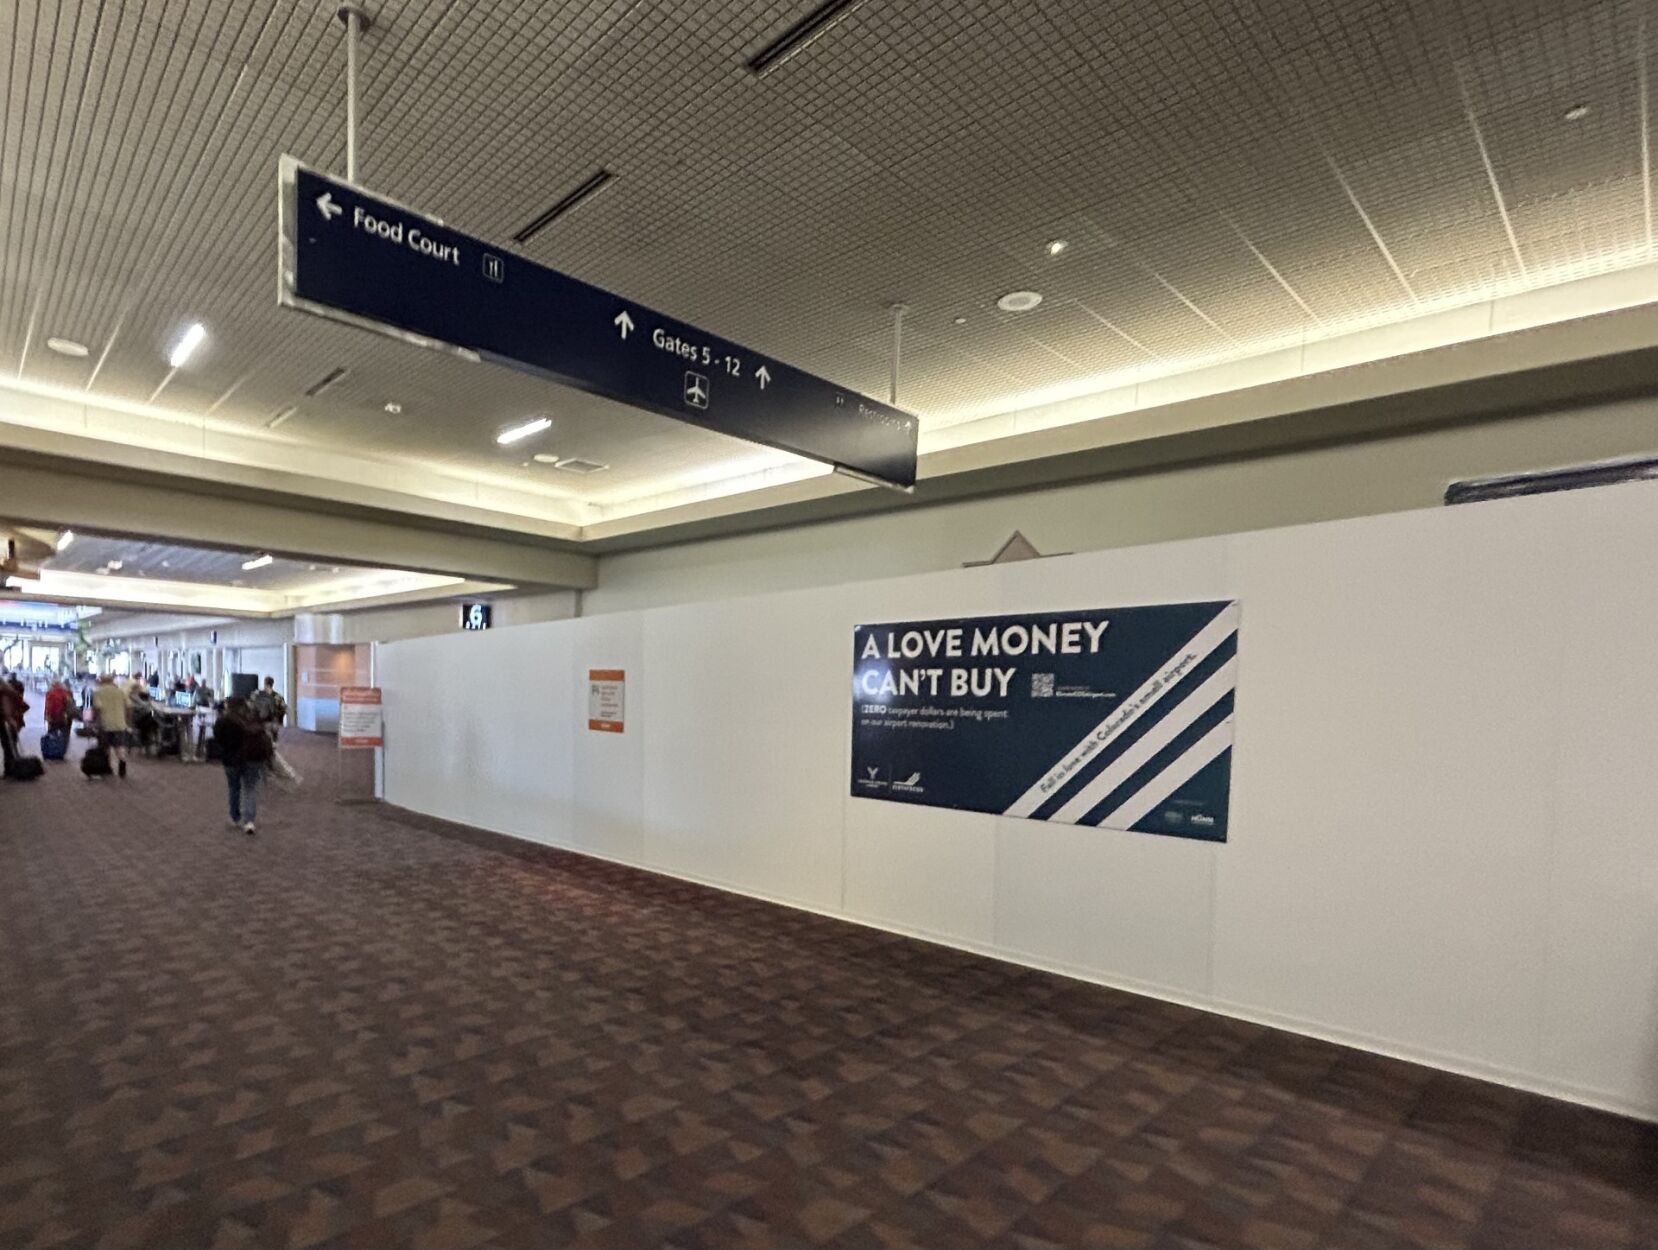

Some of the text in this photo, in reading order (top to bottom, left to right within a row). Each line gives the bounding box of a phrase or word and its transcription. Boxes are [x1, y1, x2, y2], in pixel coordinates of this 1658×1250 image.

[353, 205, 460, 266] Food Court
[653, 328, 698, 361] Gates
[702, 346, 711, 365] 5
[725, 355, 741, 376] 12
[469, 604, 483, 628] 6
[861, 620, 1110, 660] A LOVE MONEY
[861, 666, 1018, 697] CAN'T BUY
[883, 718, 908, 730] airport
[919, 706, 945, 717] dollars
[946, 708, 959, 717] are
[960, 706, 983, 720] being
[984, 708, 1008, 721] spent
[1039, 775, 1057, 794] Fall
[1081, 740, 1099, 758] with
[1096, 704, 1141, 742] Colorado's
[1162, 653, 1198, 684] airport.
